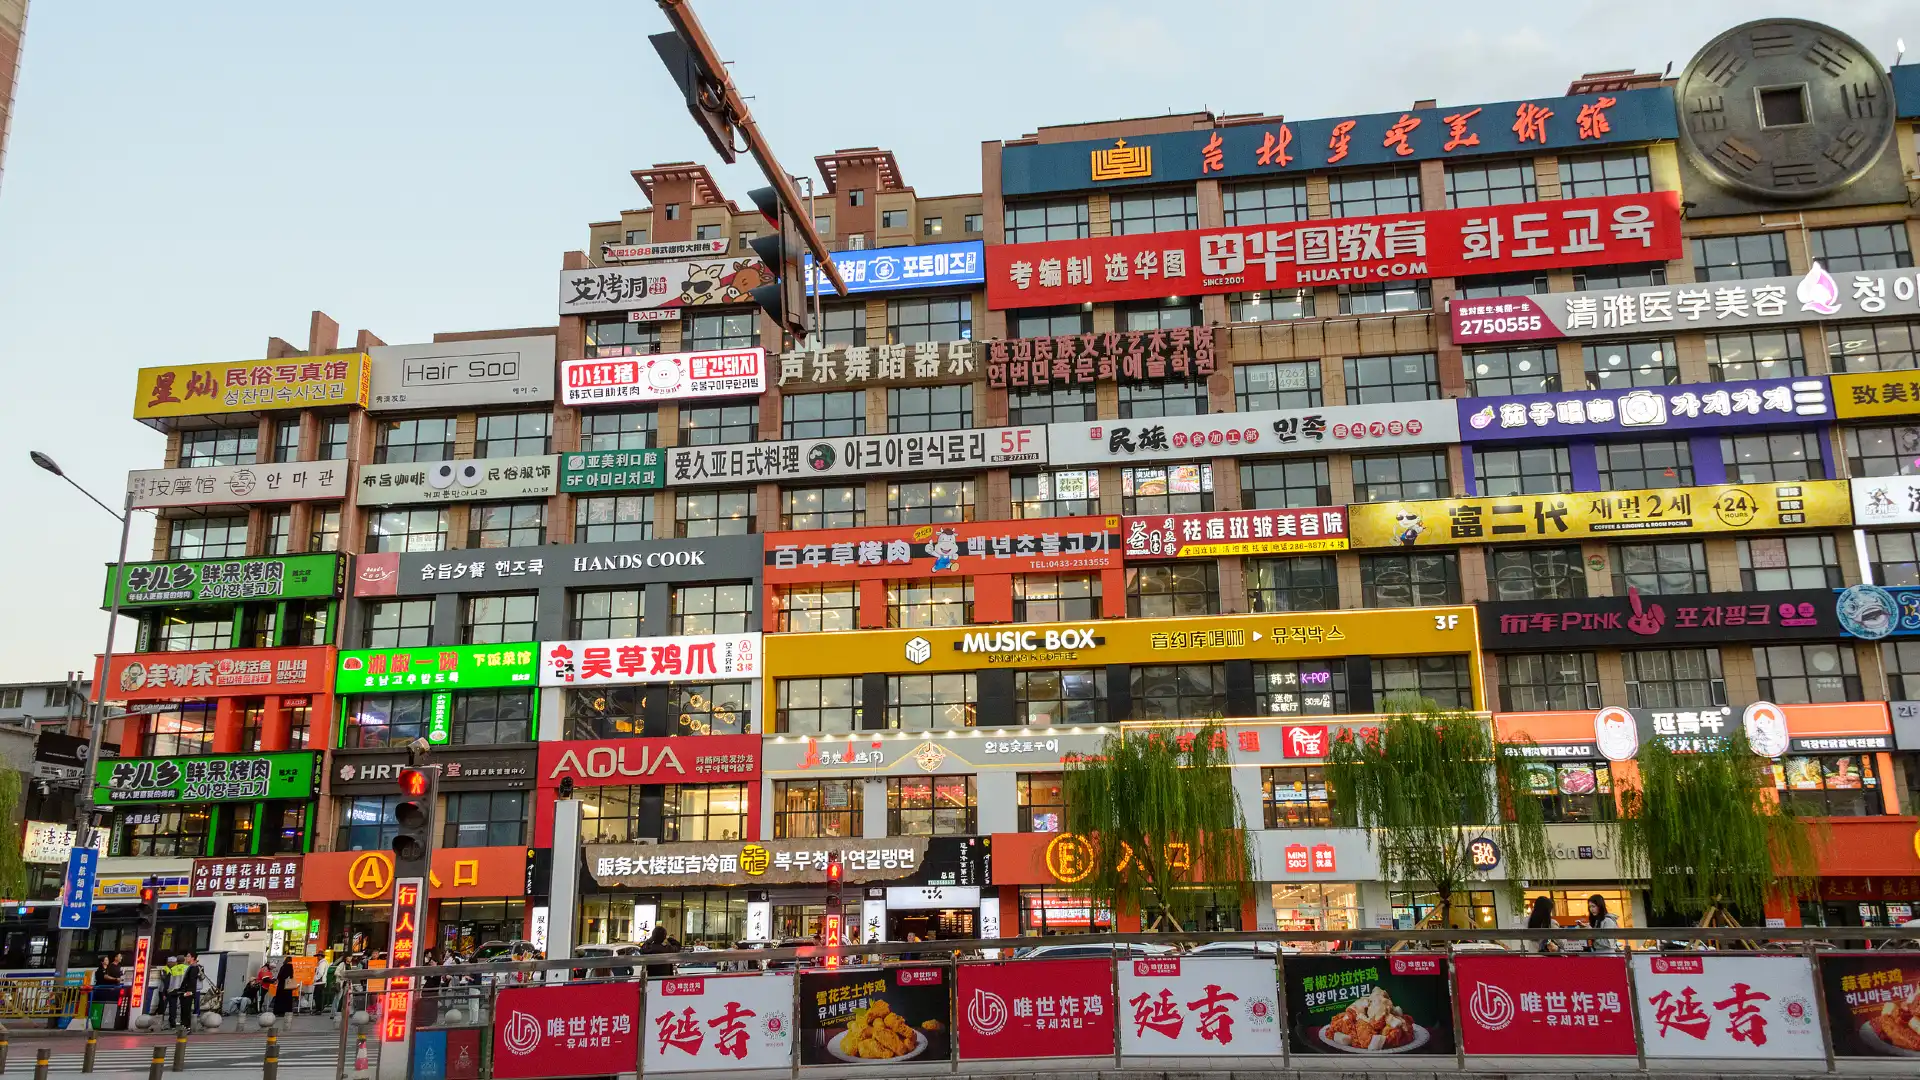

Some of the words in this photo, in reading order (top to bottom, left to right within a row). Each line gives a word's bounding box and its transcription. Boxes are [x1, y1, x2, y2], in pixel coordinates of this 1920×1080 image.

[1460, 205, 1655, 260] 화도교육
[1245, 220, 1427, 282] 华图教育
[903, 253, 965, 277] 포토이즈
[1010, 256, 1093, 290] 考编制
[1104, 249, 1186, 284] 选华图
[565, 273, 648, 304] 艾烤洞
[1203, 278, 1223, 287] SINCE
[1225, 276, 1245, 286] 2001
[1565, 284, 1787, 330] 清雅医学美容
[1460, 316, 1541, 336] 2750555
[990, 326, 1213, 363] 延边民族文化艺术学院
[225, 361, 348, 387] 民俗写真馆
[406, 362, 459, 382] Hair
[469, 360, 517, 378] Soo
[571, 363, 634, 386] 小红猪
[692, 355, 755, 377] 빨간돼지
[778, 339, 974, 387] 声乐舞蹈器乐
[988, 349, 1215, 388] 연변민족문화예술학원
[148, 371, 220, 408] 星灿
[223, 382, 346, 406] 성찬민속사진관
[569, 386, 640, 400] 韩式自助烤肉
[1108, 425, 1169, 453] 民族
[1173, 427, 1260, 448] 饮食加工部
[1273, 415, 1327, 443] 민족
[844, 433, 986, 469] 아크아일식료리
[1000, 430, 1031, 453] 5F
[586, 452, 657, 469] 亚美利口腔
[675, 445, 800, 481] 爱久亚日式料理
[362, 471, 425, 488] 布旨咖啡
[488, 465, 551, 481] 民俗服饰
[566, 474, 583, 487] 5F
[586, 470, 656, 487] 아미리치과
[148, 475, 217, 497] 按摩馆
[1589, 494, 1692, 519] 재벌2세
[1724, 497, 1747, 512] 24
[1183, 512, 1343, 541] 祛痘斑皱美容院
[1449, 500, 1569, 538] 富二代
[775, 539, 911, 570] 百年草烤肉
[967, 530, 1109, 560] 백년초불고기
[201, 561, 284, 583] 鲜果烤肉
[421, 562, 486, 581] 含旨夕餐
[495, 559, 544, 577] 핸즈쿡
[573, 553, 643, 572] HANDS
[646, 550, 706, 567] COOK
[1030, 558, 1109, 569] TEL:0433-2313555
[1434, 615, 1458, 630] 3F
[1675, 604, 1771, 628] 포차핑크
[963, 631, 1036, 653] MUSIC
[1045, 628, 1096, 651] BOX
[1270, 625, 1345, 644] 뮤직박스
[473, 651, 531, 667] 下饭菜馆
[581, 642, 717, 679] 吴草鸡爪
[988, 654, 1028, 663] SINGING
[1030, 654, 1038, 662] &
[1040, 652, 1078, 661] COFFEE
[1271, 672, 1296, 685] 韩式
[1300, 672, 1329, 684] K-POP
[185, 758, 271, 782] 鲜果烤肉
[549, 746, 686, 780] AQUA
[125, 814, 161, 825] 全国总店
[1471, 842, 1492, 852] CHA
[196, 863, 296, 877] 心语鲜花礼品店
[597, 853, 738, 877] 服务大楼延吉冷面
[1473, 855, 1496, 865] DAO
[356, 858, 384, 889] A
[1302, 966, 1379, 992] 青椒沙拉炸鸡
[1840, 968, 1903, 991] 蒜香炸鸡
[816, 979, 887, 1006] 雪花芝士炸鸡
[1520, 990, 1622, 1014] 唯世炸鸡
[1013, 995, 1104, 1018] 唯世炸鸡
[1129, 983, 1240, 1046] 延吉
[1649, 982, 1771, 1047] 延吉
[547, 1013, 631, 1037] 唯世炸鸡
[655, 1002, 756, 1060] 延吉
[1036, 1017, 1083, 1030] 유세치킨
[1546, 1014, 1600, 1027] 유세치킨
[566, 1036, 611, 1049] 유세치킨
